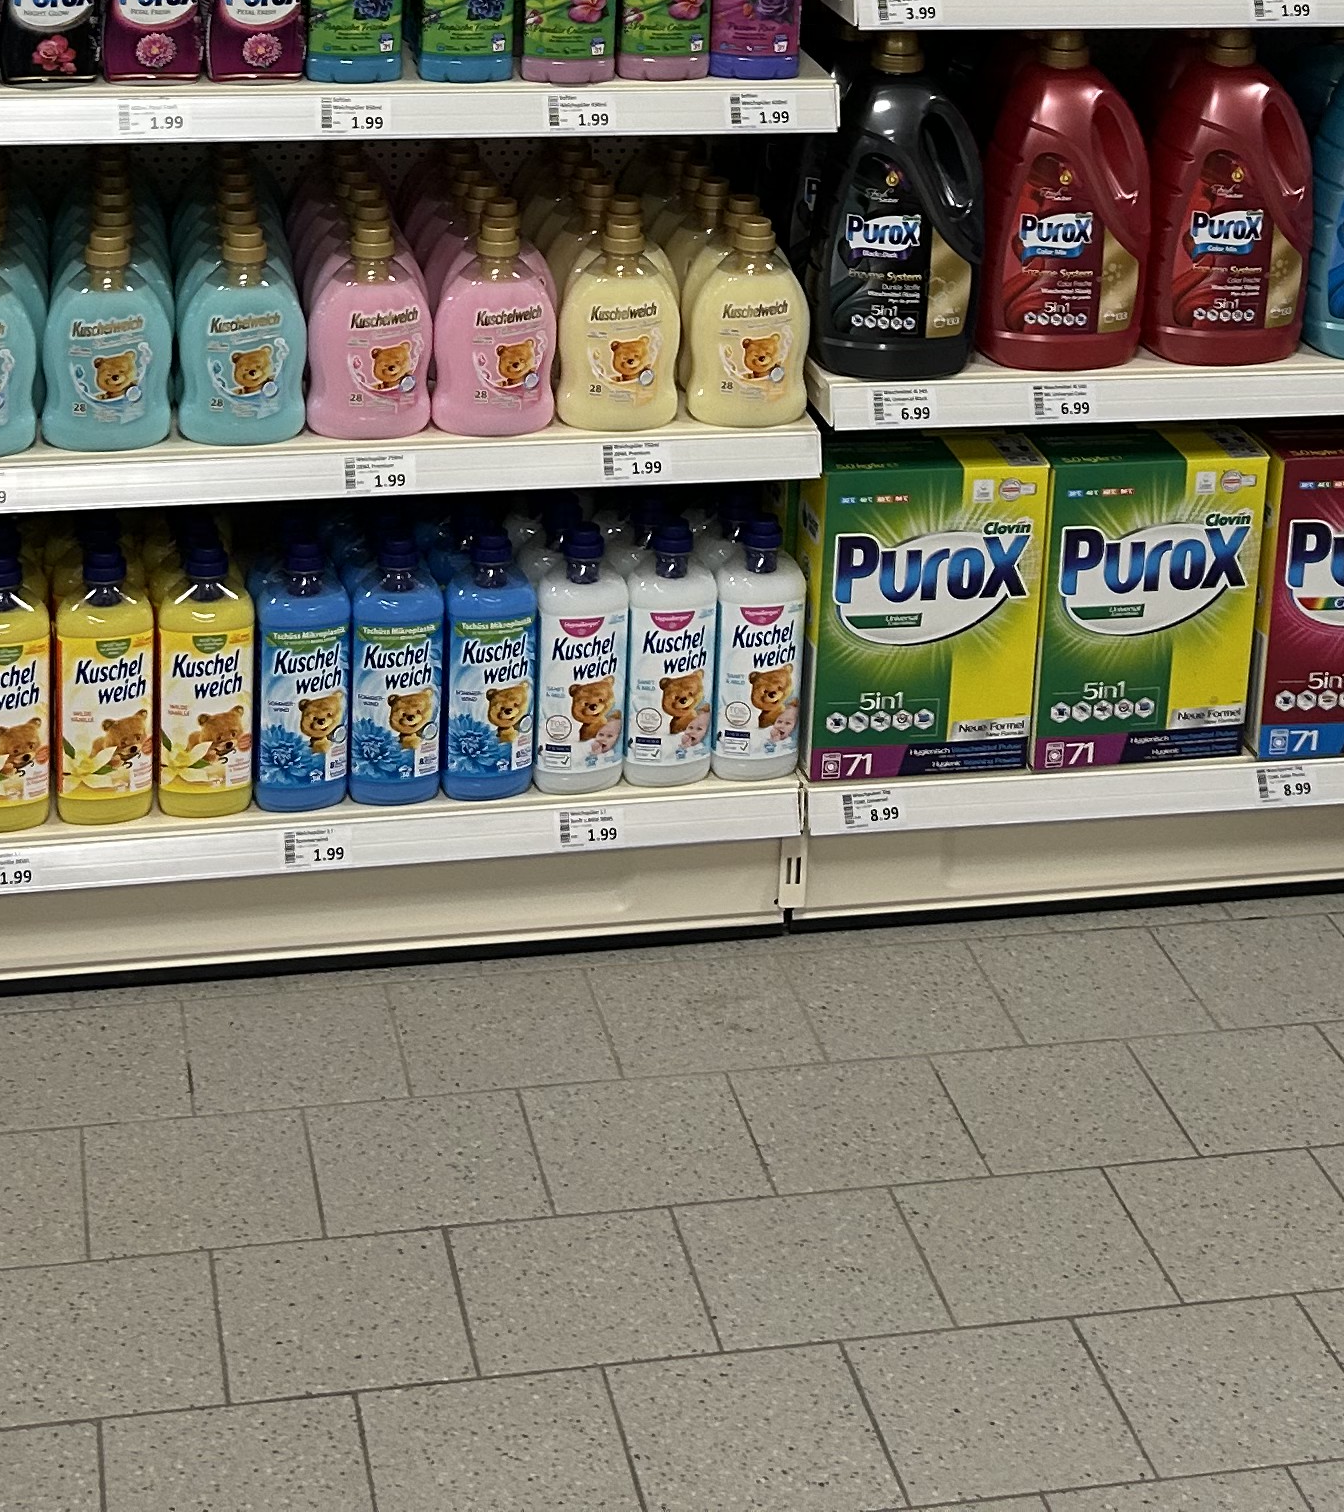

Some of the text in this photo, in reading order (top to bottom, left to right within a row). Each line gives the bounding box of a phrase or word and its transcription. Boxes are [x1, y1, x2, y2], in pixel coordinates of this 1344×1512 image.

[906, 6, 936, 19] 3.99
[1281, 4, 1310, 16] 1.99
[351, 116, 383, 130] 1.99
[846, 214, 920, 245] PuroX
[1191, 210, 1262, 240] PuroX
[350, 307, 419, 329] Kuschelweich
[722, 300, 788, 319] Kuschelweich
[1060, 402, 1089, 415] 6.99
[631, 461, 662, 475] 1.99
[835, 533, 1030, 604] PuroX
[552, 632, 616, 660] Kuschel
[572, 655, 617, 680] weich
[860, 692, 904, 711] 5in1
[1290, 729, 1318, 751] 71
[846, 754, 874, 776] 71
[1284, 781, 1311, 796] 8.99
[870, 806, 899, 821] 8.99
[313, 847, 344, 862] 1.99
